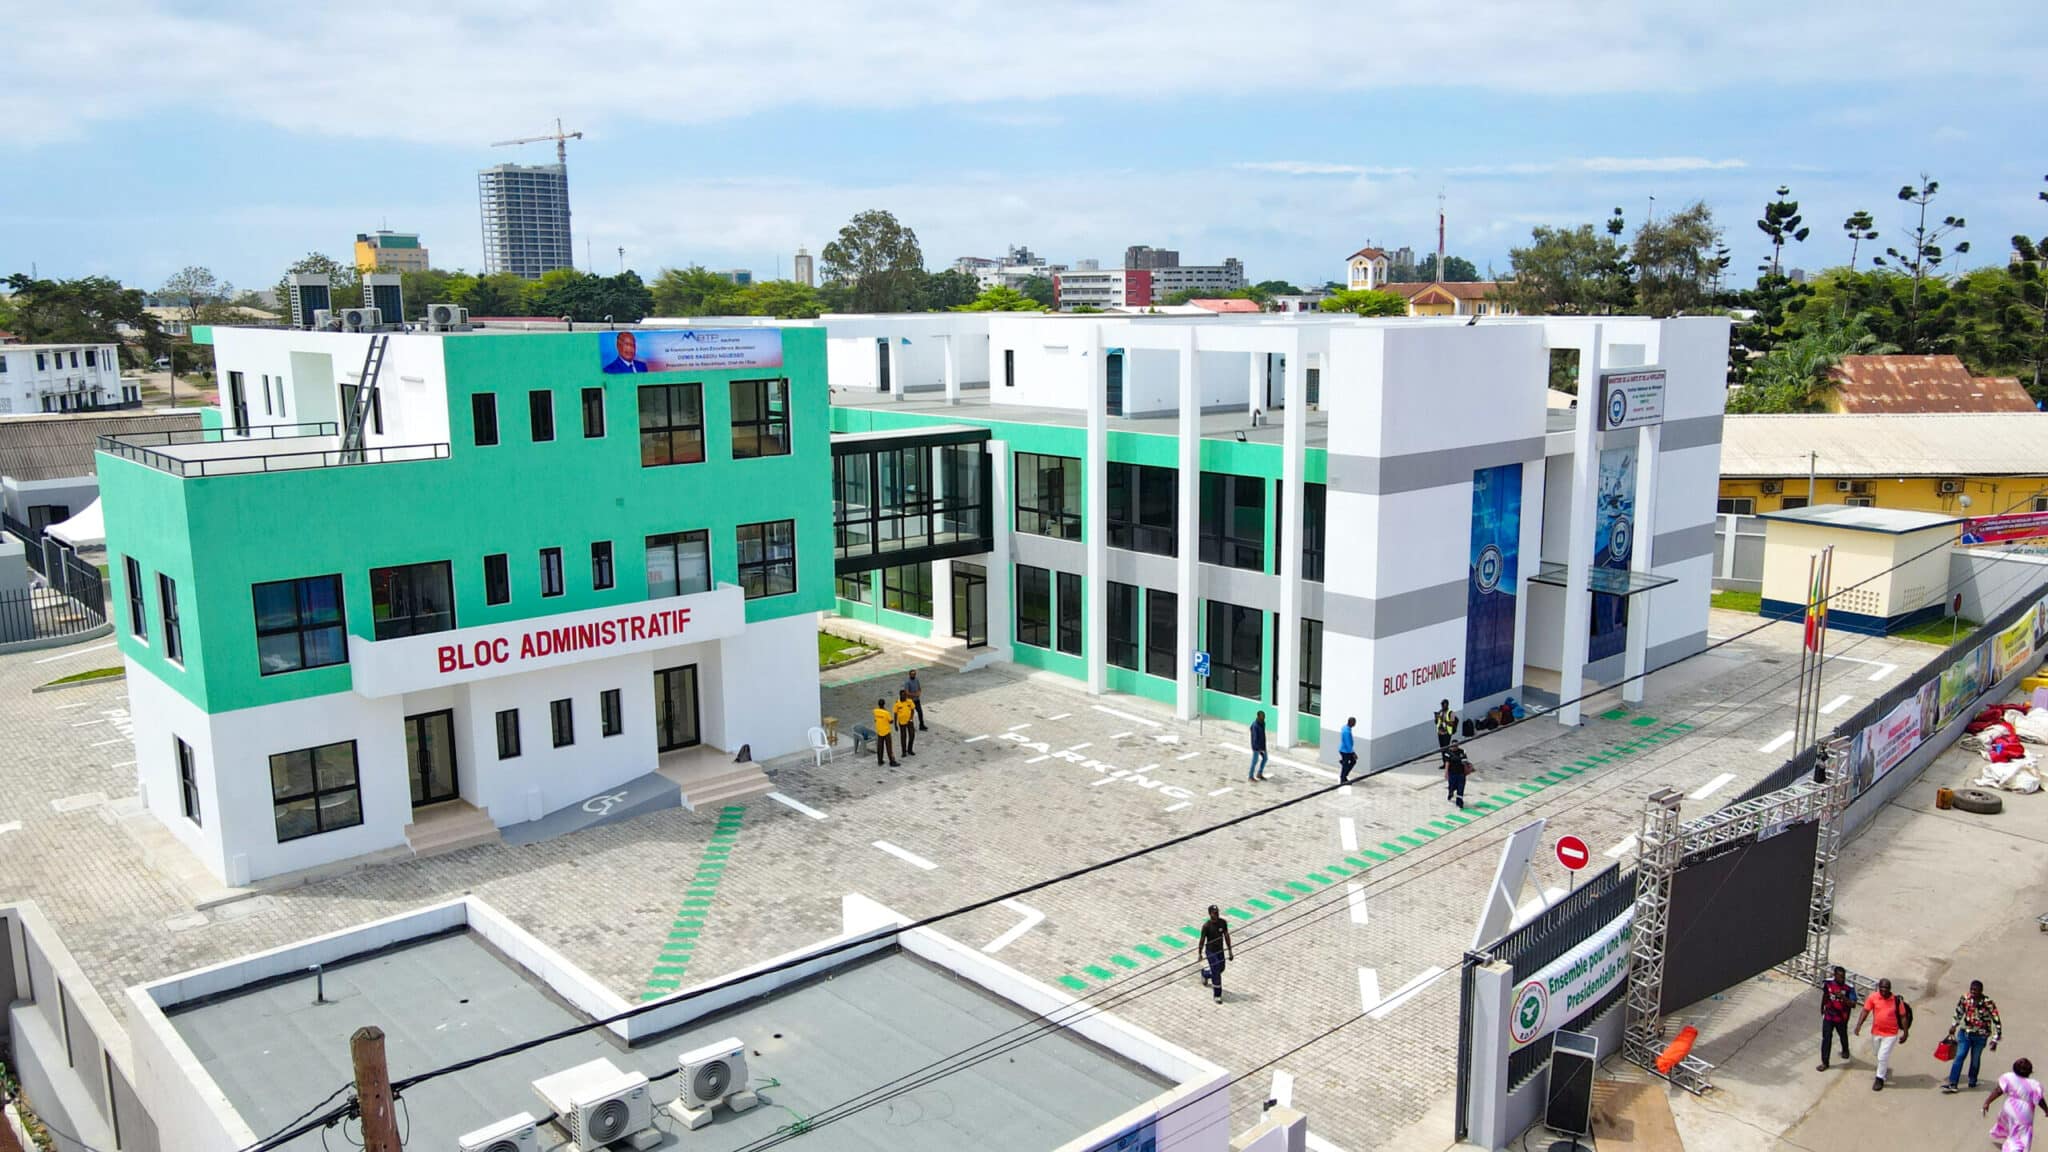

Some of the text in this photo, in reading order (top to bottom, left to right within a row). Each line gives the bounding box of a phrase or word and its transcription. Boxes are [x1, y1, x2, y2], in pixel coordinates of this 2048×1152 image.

[437, 608, 691, 673] BLOC ADMINISTRATIF
[1383, 657, 1457, 696] BLOC TECHNIQUE
[998, 732, 1196, 799] PARKING
[1548, 957, 1588, 995] Ensemble
[1589, 945, 1606, 973] pour
[1606, 935, 1619, 954] une
